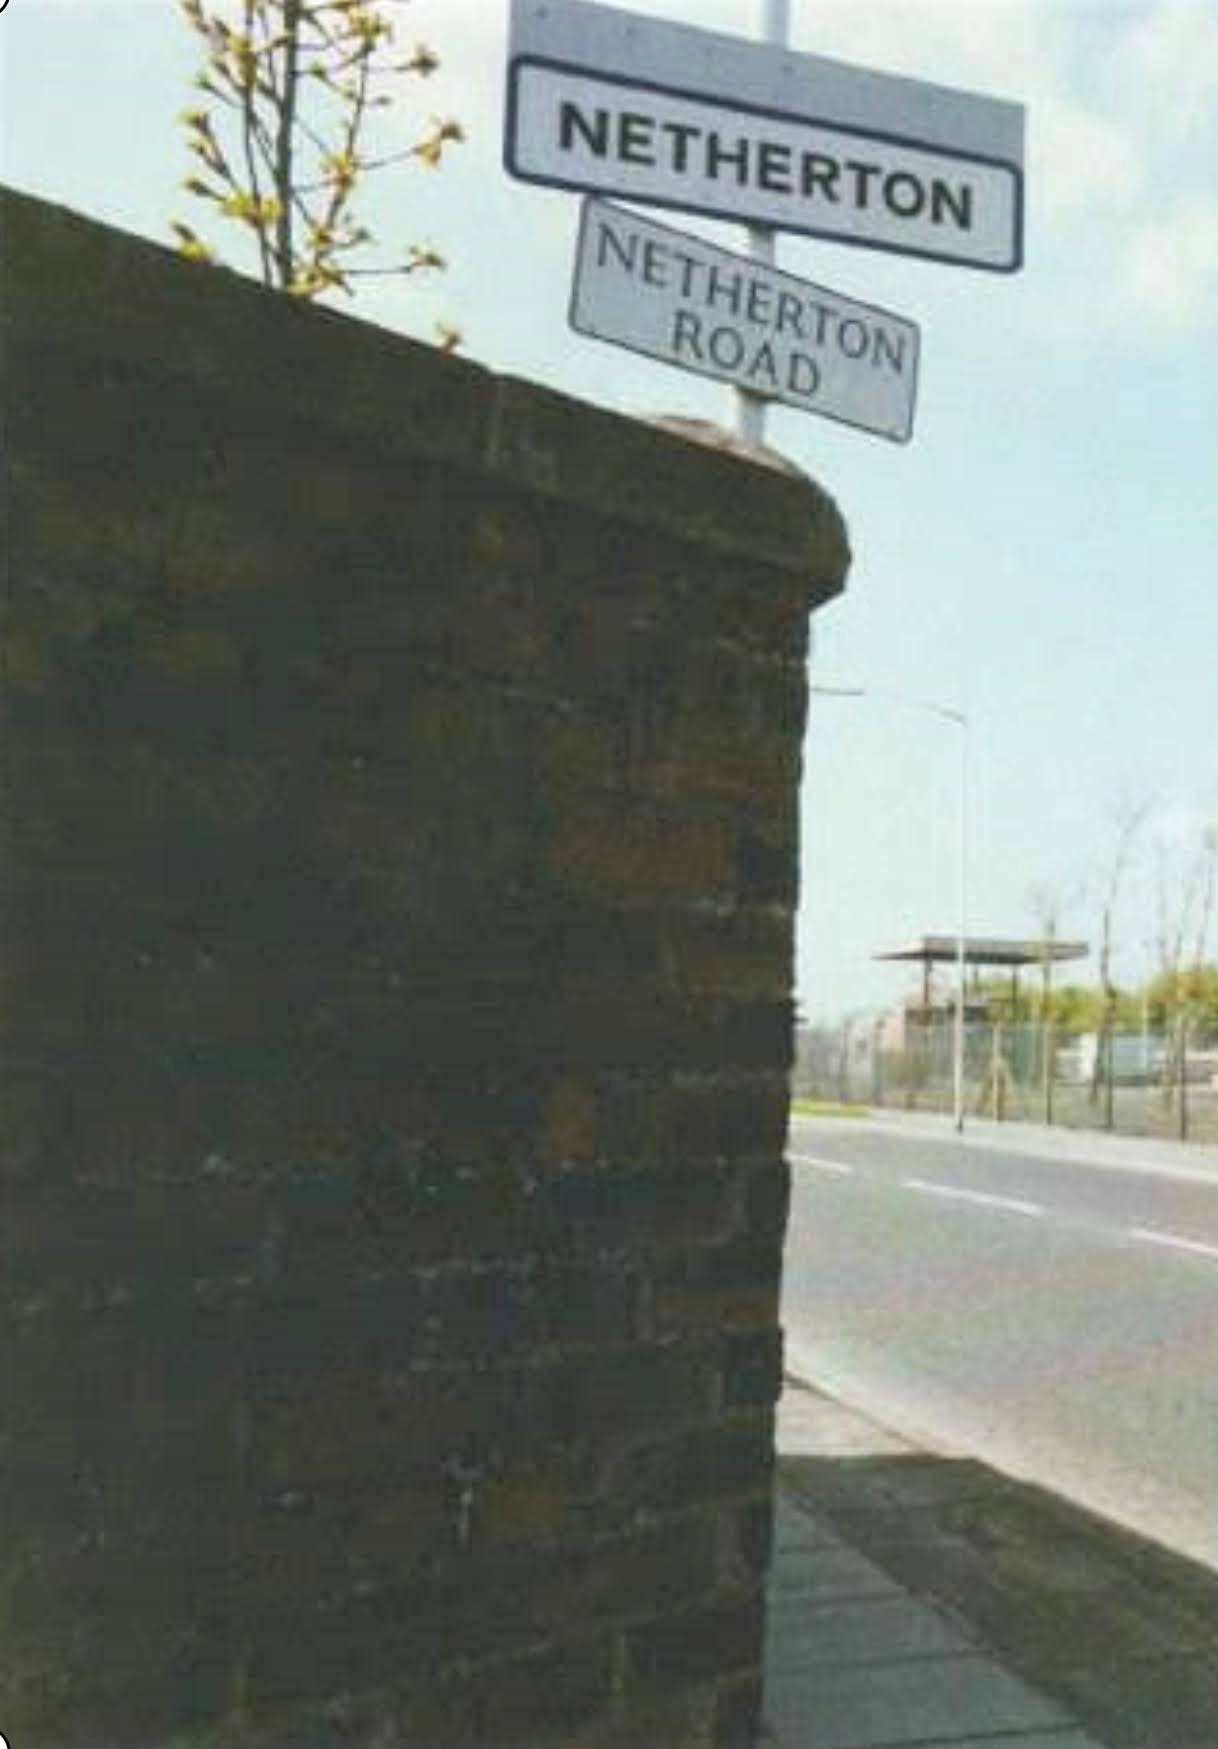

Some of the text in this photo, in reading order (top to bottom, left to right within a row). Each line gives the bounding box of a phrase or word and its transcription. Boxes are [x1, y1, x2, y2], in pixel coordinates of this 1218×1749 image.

[558, 102, 972, 231] NETHERTON
[597, 223, 905, 372] NETHERTON
[671, 310, 821, 397] ROAD
